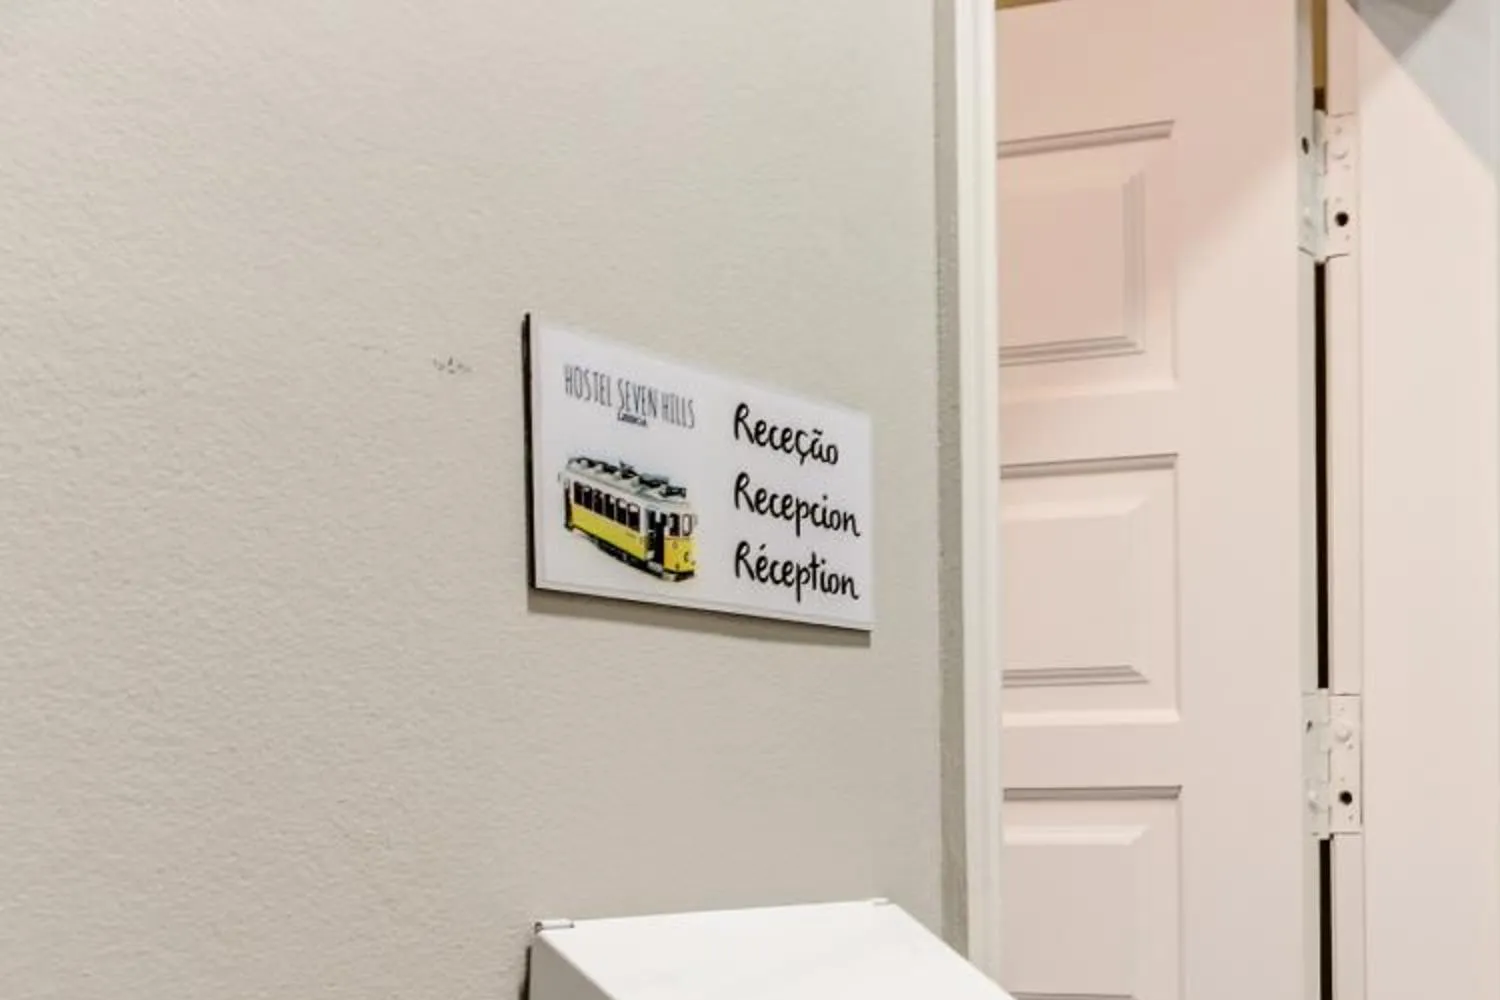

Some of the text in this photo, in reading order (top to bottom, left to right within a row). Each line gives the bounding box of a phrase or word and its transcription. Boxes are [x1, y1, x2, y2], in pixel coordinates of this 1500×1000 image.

[564, 364, 695, 430] HOSTEL SEVEN HILLS
[734, 402, 839, 466] Receção
[734, 471, 861, 538] Recepcion
[735, 540, 860, 604] Réception
